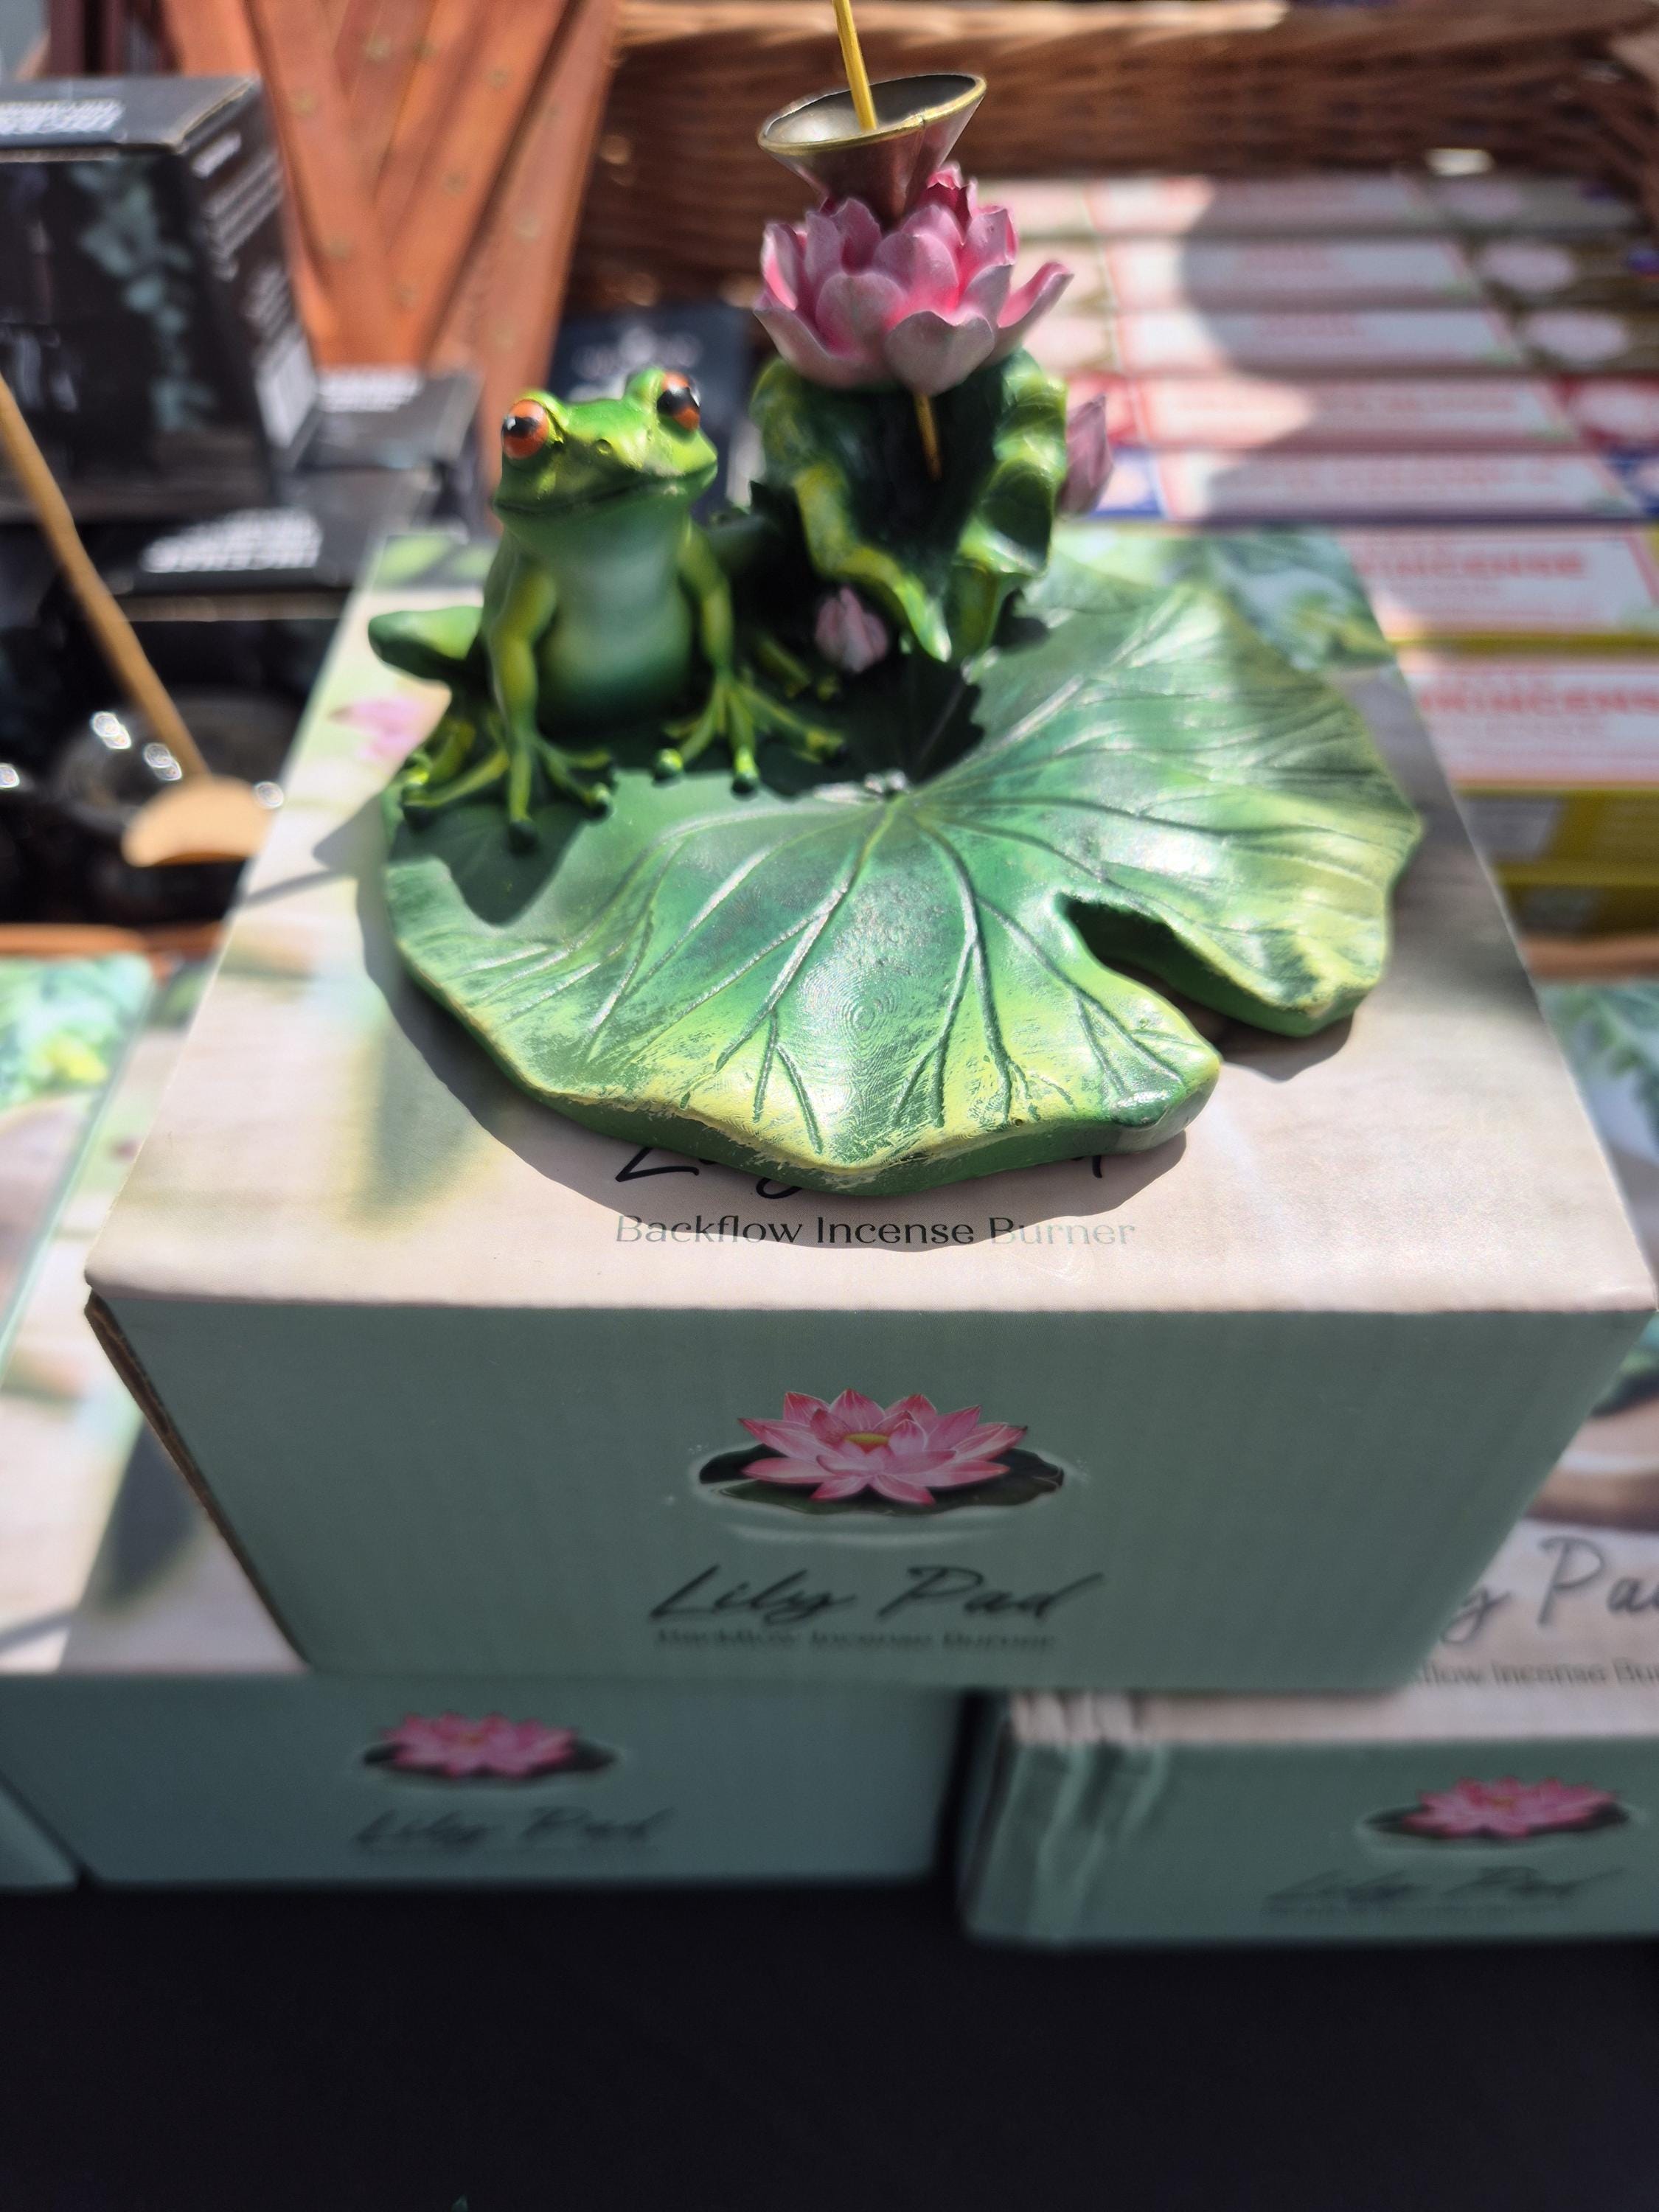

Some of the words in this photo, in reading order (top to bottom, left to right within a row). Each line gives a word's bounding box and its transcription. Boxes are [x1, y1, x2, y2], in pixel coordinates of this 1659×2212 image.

[616, 1214, 803, 1243] Backflow
[817, 1216, 975, 1245] Incense
[988, 1217, 1135, 1245] Burner
[650, 1563, 858, 1625] Lily
[877, 1565, 1105, 1618] Pad
[1535, 1534, 1659, 1627] Pa
